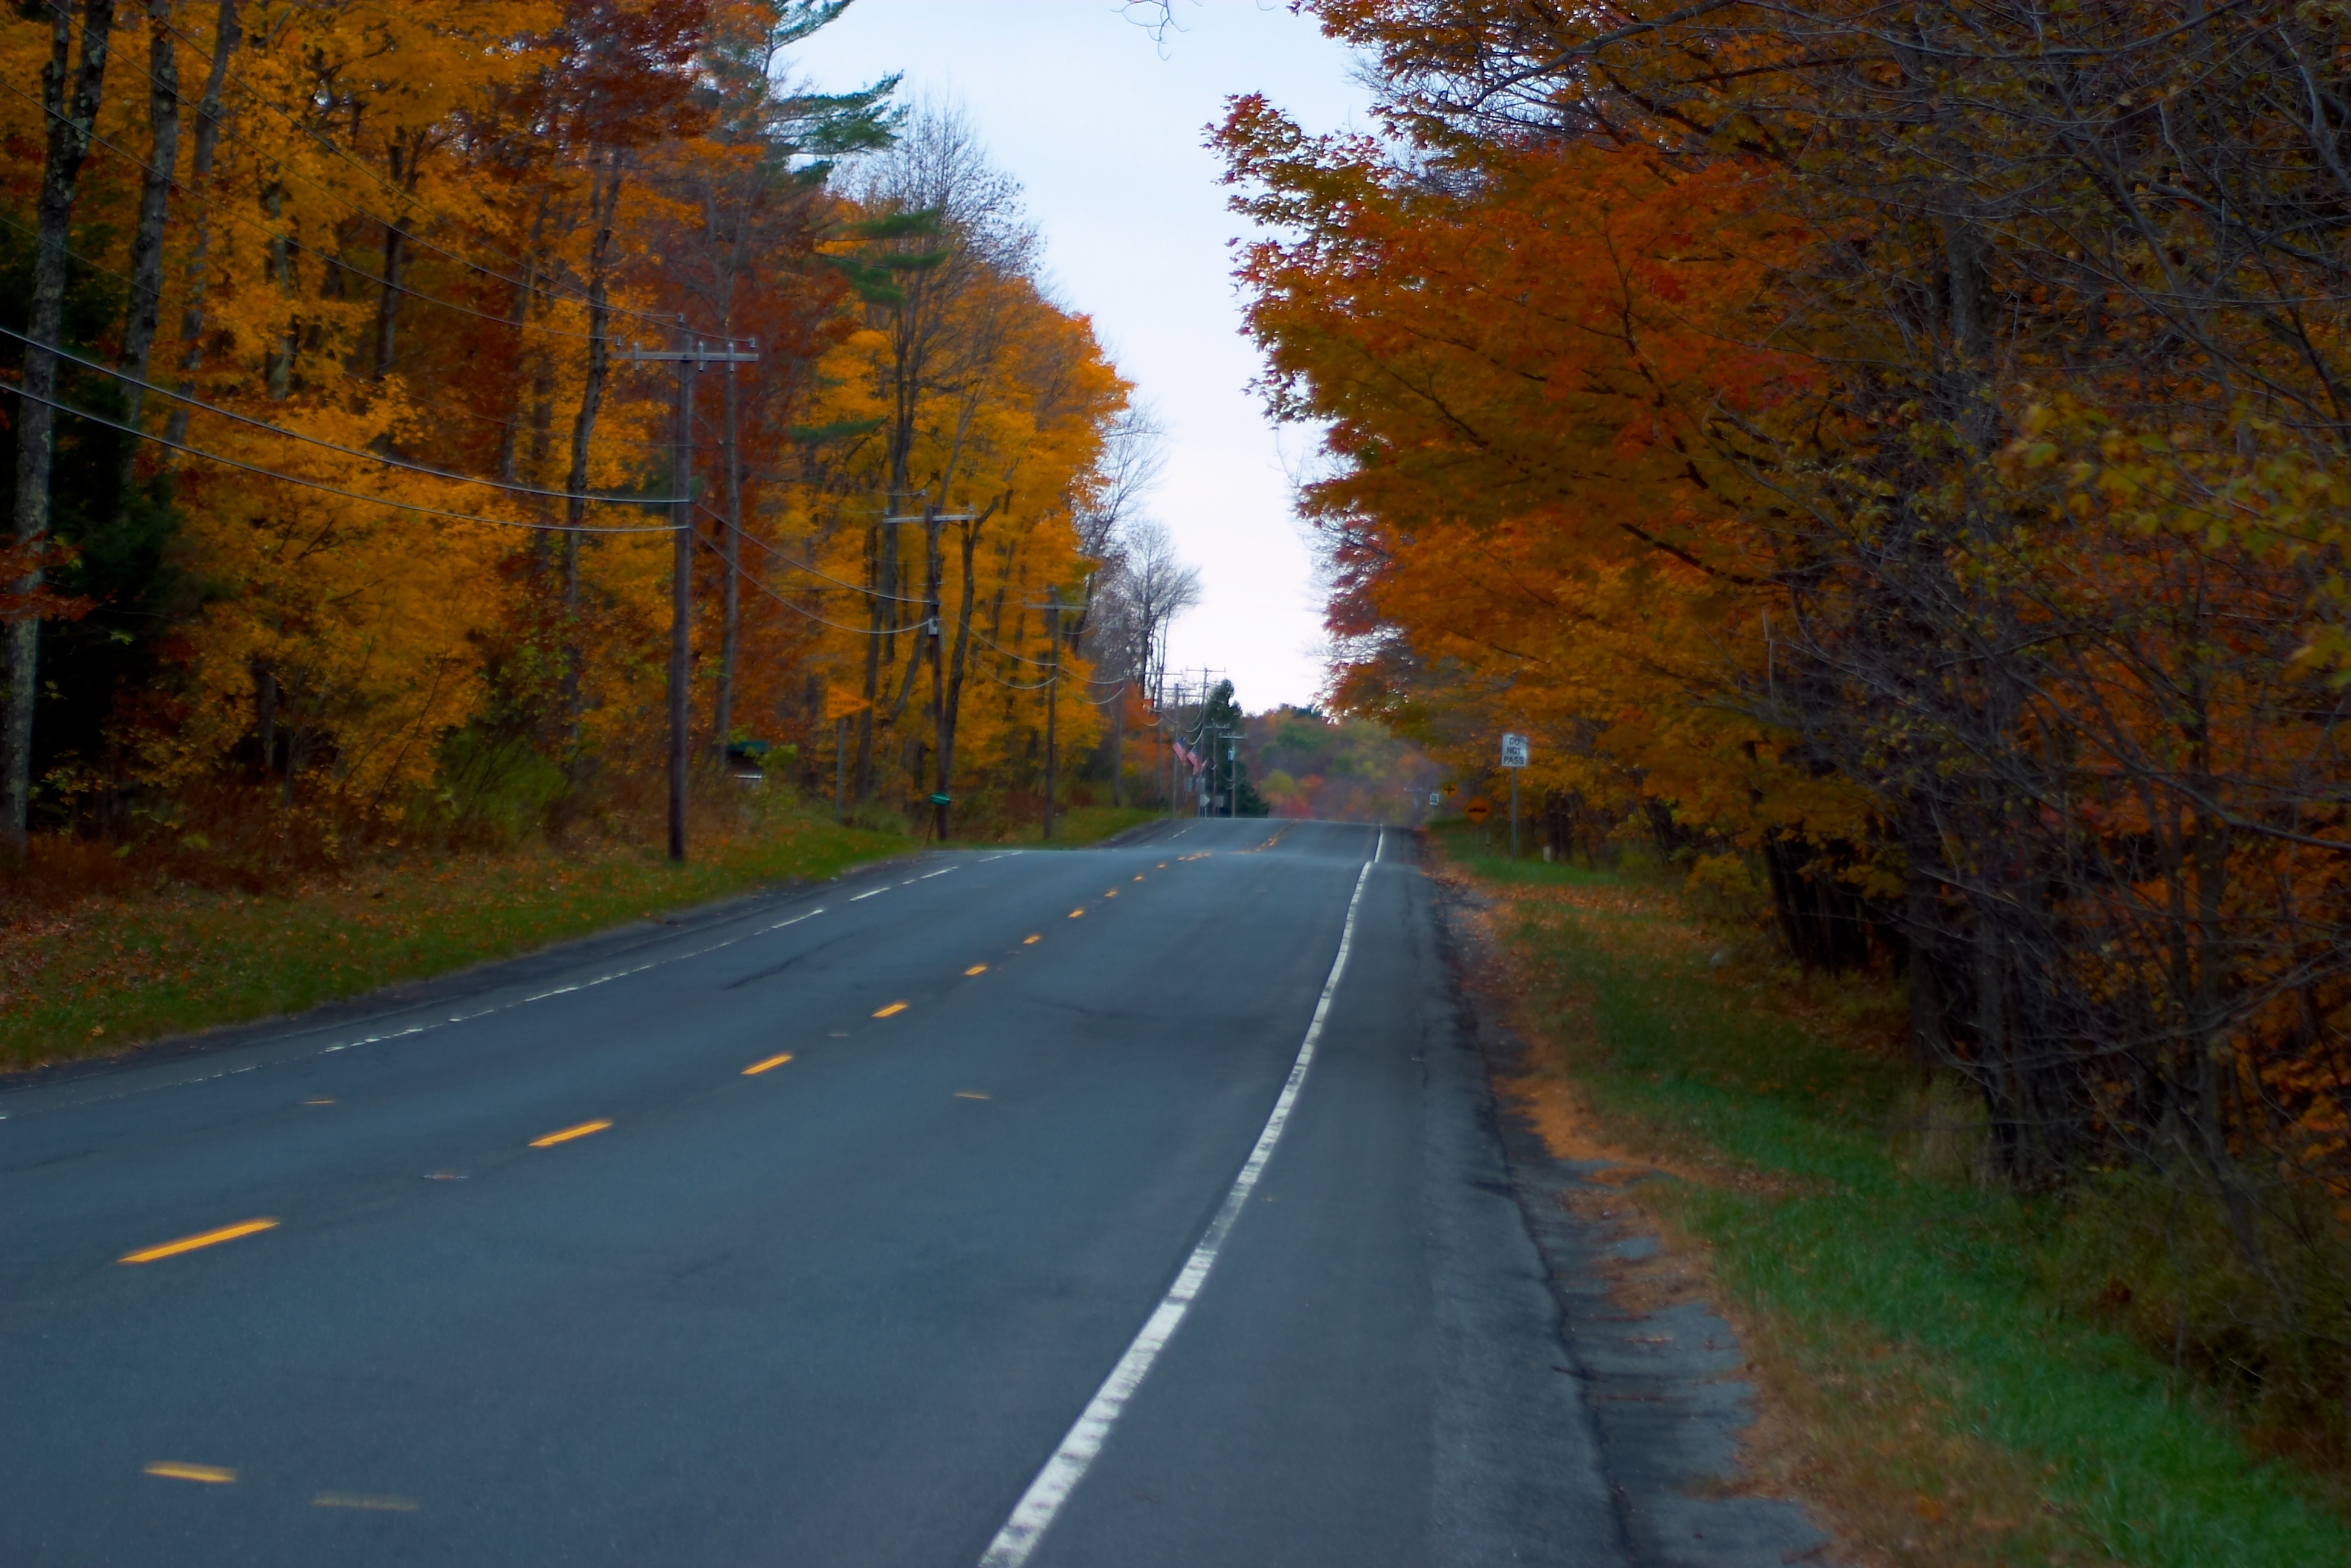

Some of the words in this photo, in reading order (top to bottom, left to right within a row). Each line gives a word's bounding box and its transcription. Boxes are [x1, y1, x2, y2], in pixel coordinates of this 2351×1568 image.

[1509, 737, 1520, 746] DO
[1506, 747, 1521, 755] NOT
[1503, 756, 1524, 765] PASS
